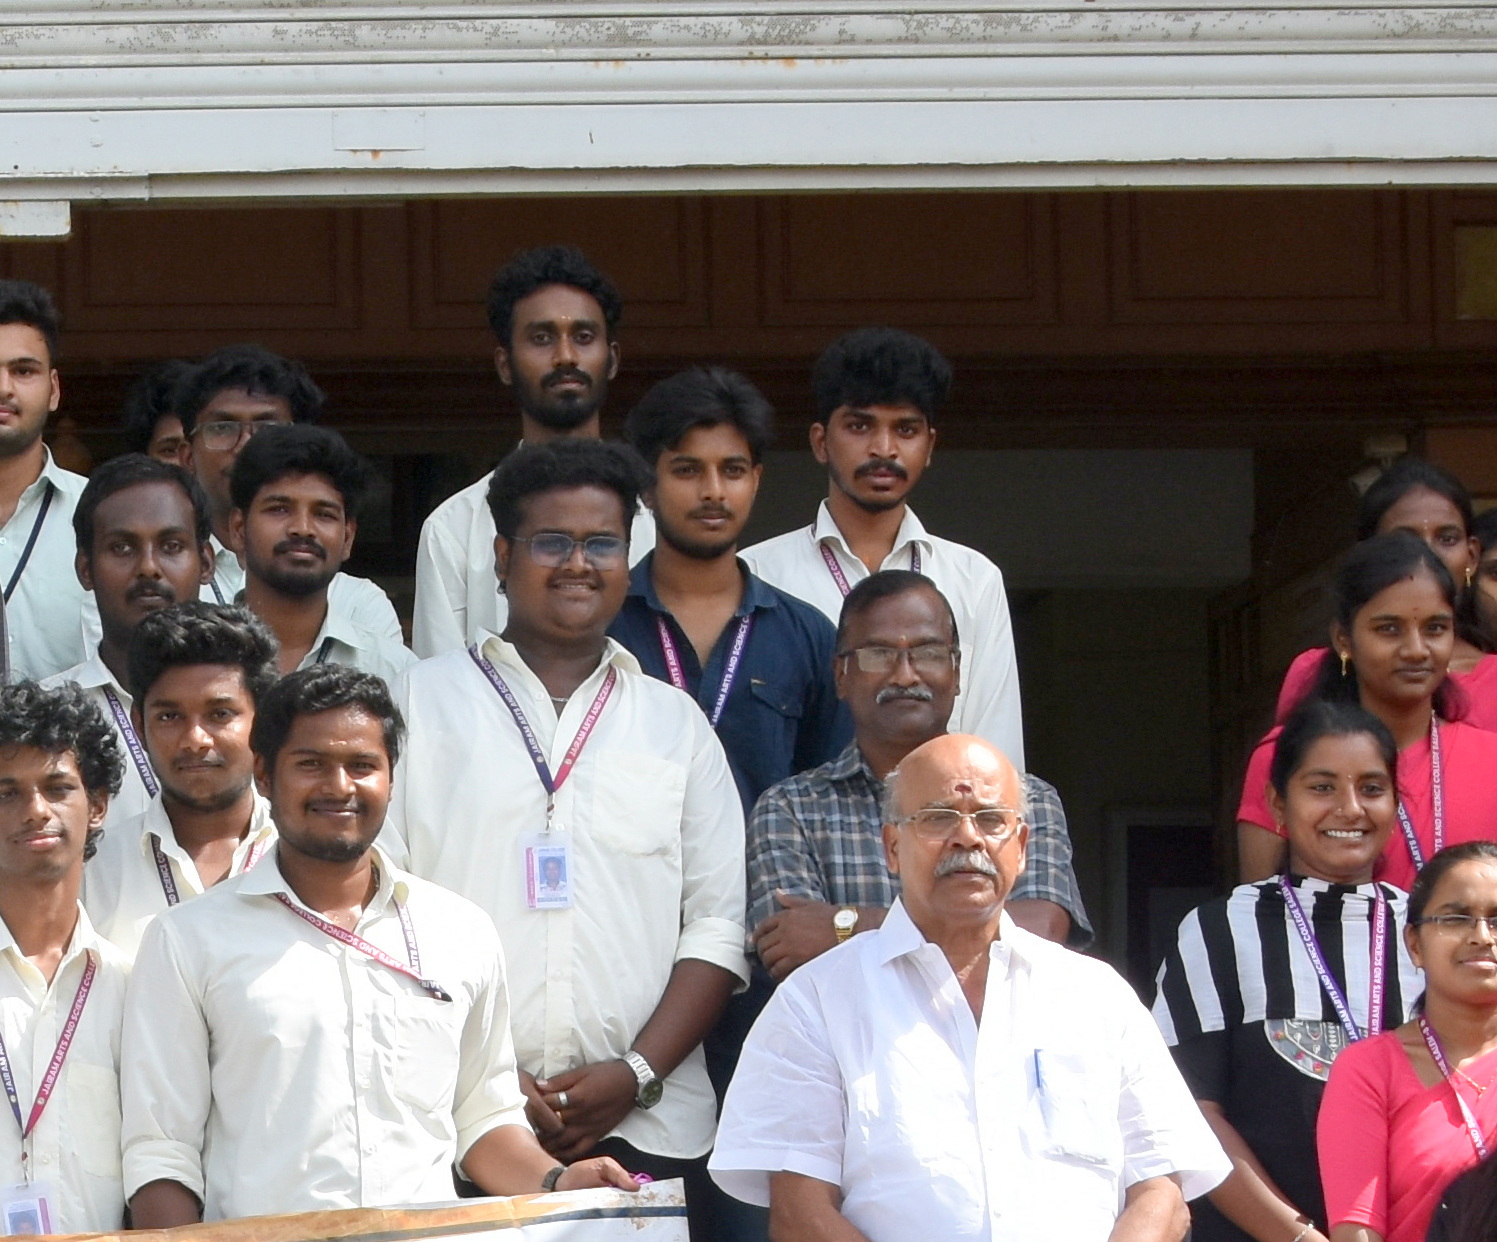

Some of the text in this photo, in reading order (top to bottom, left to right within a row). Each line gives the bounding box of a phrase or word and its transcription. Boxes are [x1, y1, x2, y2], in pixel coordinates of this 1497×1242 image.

[504, 692, 517, 708] AND
[513, 706, 527, 725] ARTS
[124, 728, 137, 745] AND
[522, 724, 541, 754] JAIRAM
[568, 729, 587, 757] JAIRAM
[581, 714, 595, 731] ARTS
[589, 700, 602, 715] AND
[131, 744, 145, 765] ARTS
[1433, 784, 1442, 816] SCIENCE
[1434, 818, 1442, 835] AND
[1401, 820, 1422, 862] ARTS AND
[1280, 885, 1297, 909] SALEM
[321, 921, 359, 946] SCIENCE
[1290, 907, 1311, 942] COLLEGE
[357, 940, 379, 957] AND
[1305, 941, 1326, 975] SCIENCE
[1374, 934, 1383, 966] SCIENCE
[1319, 973, 1334, 991] AND
[1373, 967, 1382, 983] AND
[1328, 990, 1343, 1010] ARTS
[1372, 984, 1381, 1004] ARTS
[41, 985, 88, 1095] JAIRAM ARTS AND SCIENCE
